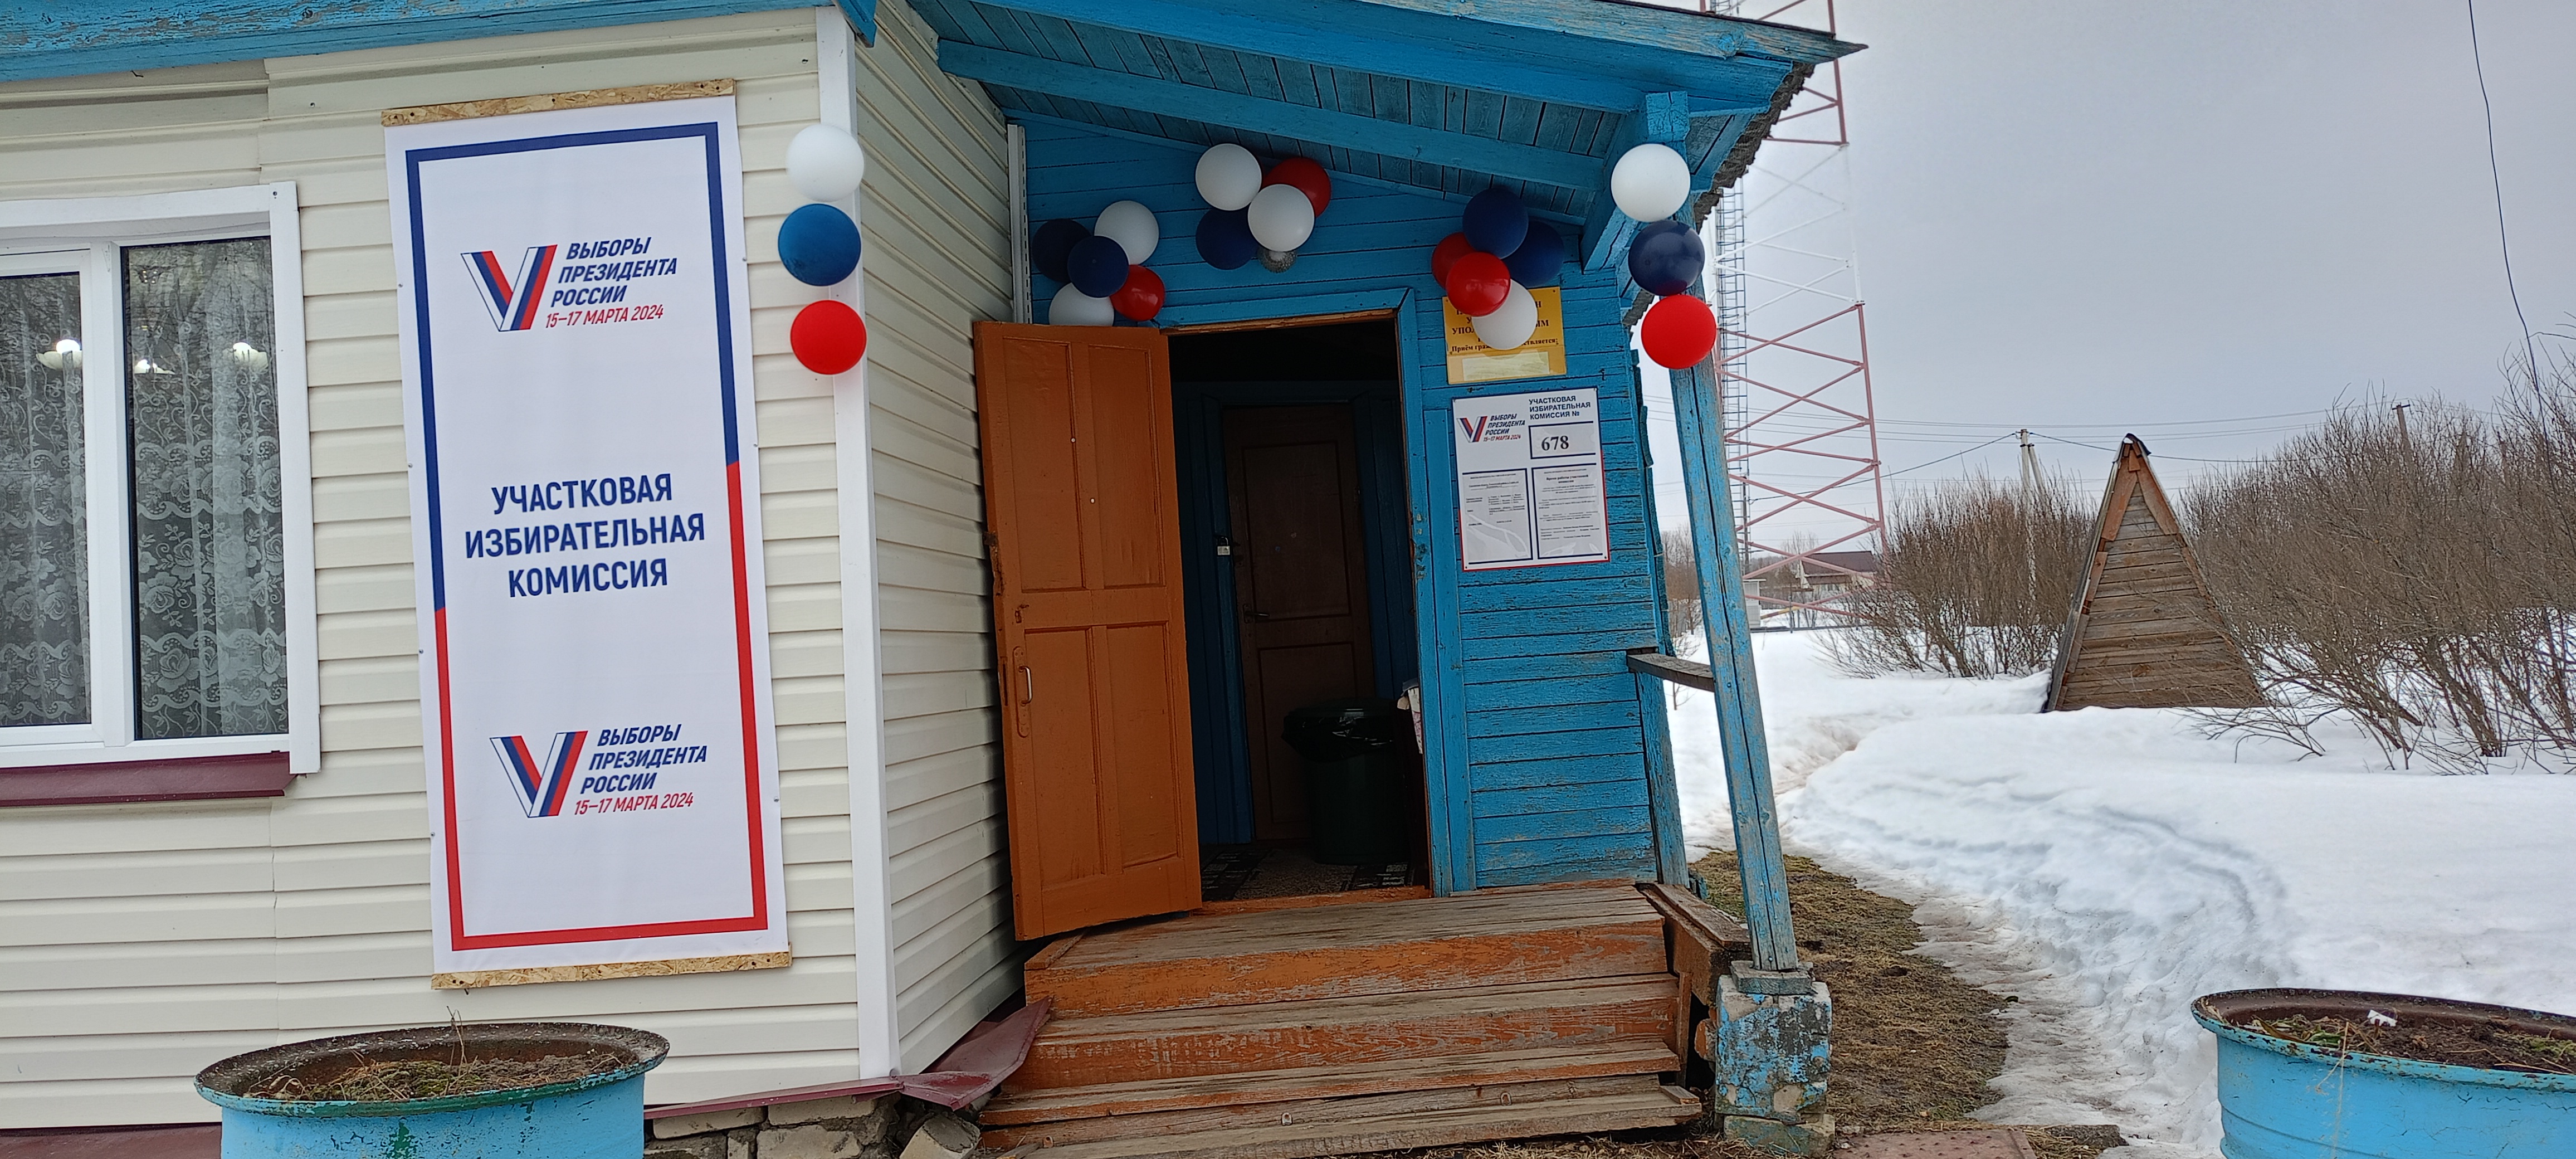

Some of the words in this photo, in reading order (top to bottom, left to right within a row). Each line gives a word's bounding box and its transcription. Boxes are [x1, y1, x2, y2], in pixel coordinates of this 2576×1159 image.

[566, 237, 651, 260] ВЫБОРЫ
[558, 258, 677, 283] ПРЕЗИДЕНТА
[550, 285, 627, 308] РОССИИ
[583, 308, 628, 325] МАРТА
[631, 304, 663, 322] 2024
[1529, 396, 1576, 405] УЧАСТКОВАЯ
[1529, 402, 1591, 412] ИЗБИРАТЕЛЬНАЯ
[1530, 411, 1570, 420] КОМИССИЯ
[1541, 436, 1569, 450] 678
[491, 473, 672, 515] УЧАСТКОВАЯ
[465, 513, 705, 558] ИЗБИРАТЕЛЬНАЯ
[508, 558, 668, 597] КОМИССИЯ
[597, 724, 682, 747] ВЫБОРЫ
[588, 746, 708, 771] ПРЕЗИДЕНТА
[580, 772, 657, 794] РОССИИ
[613, 795, 658, 812] МАРТА
[661, 792, 694, 809] 2024
